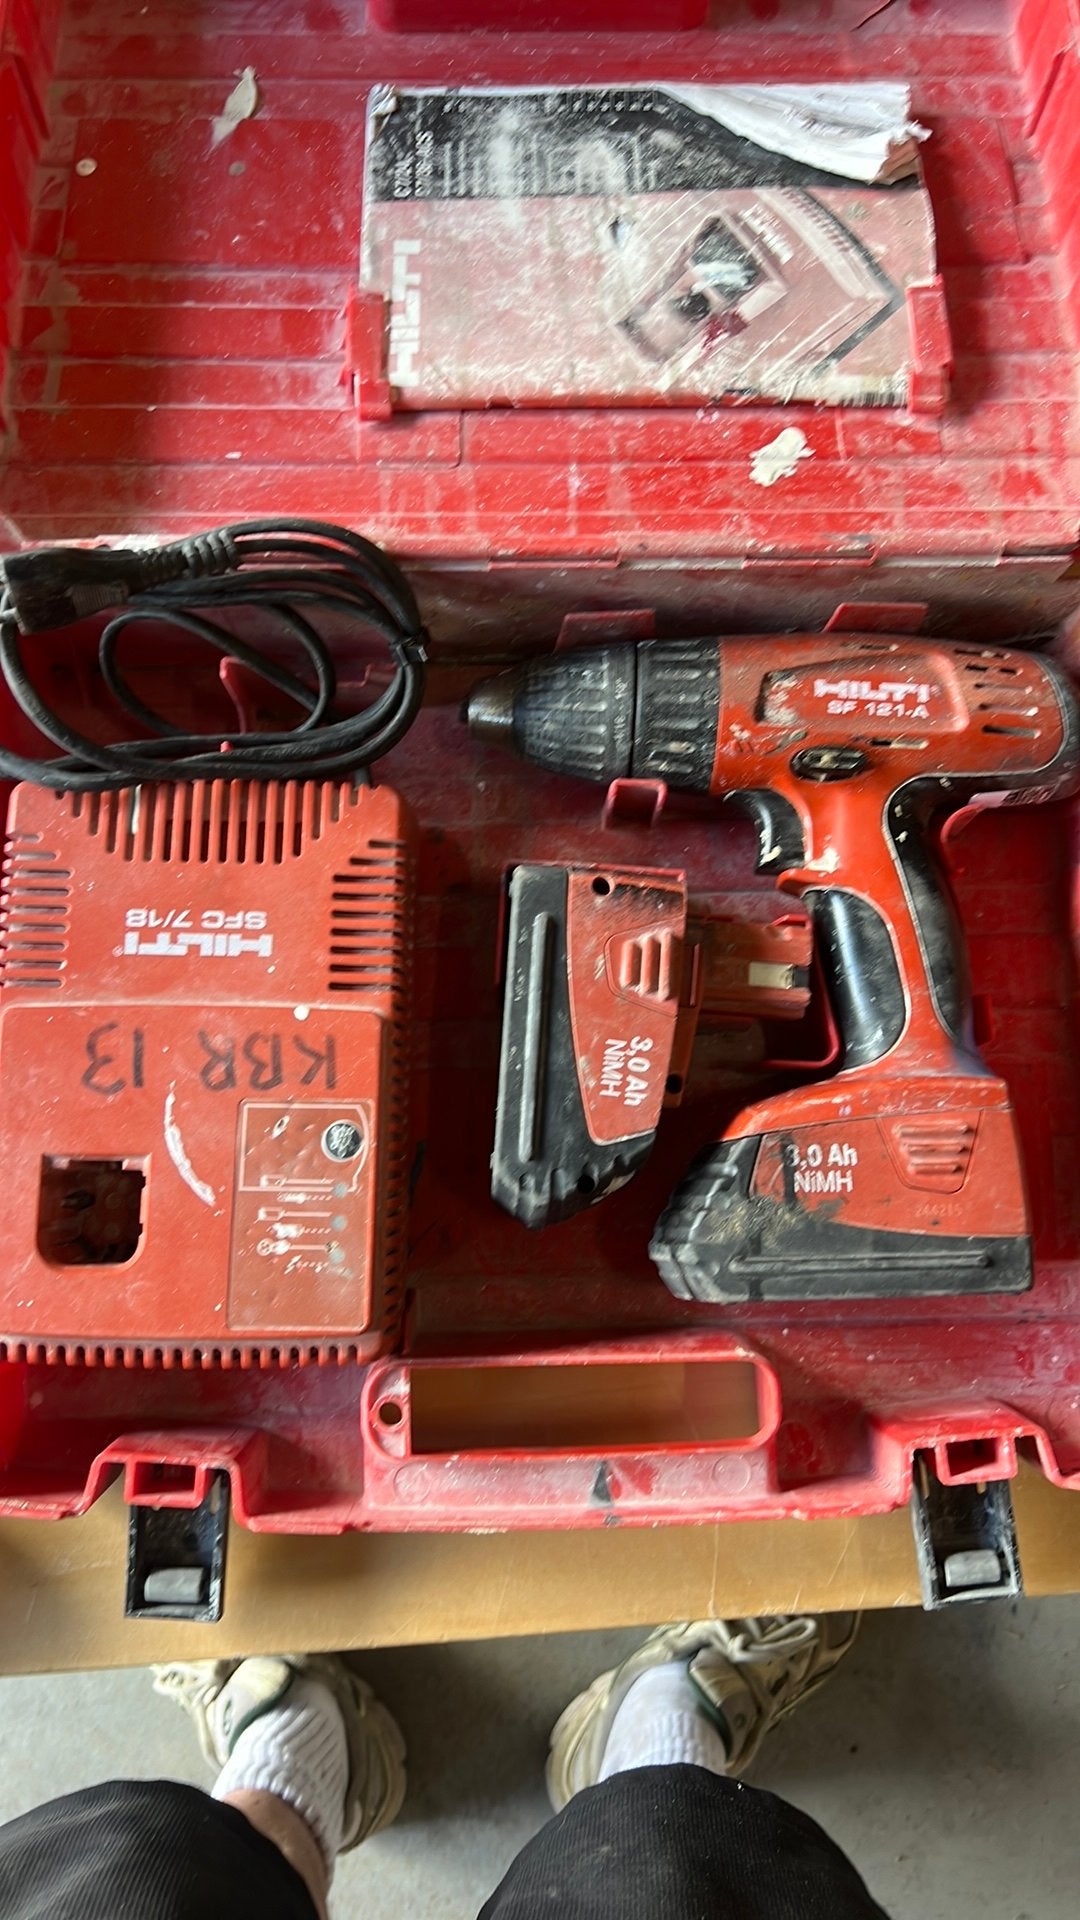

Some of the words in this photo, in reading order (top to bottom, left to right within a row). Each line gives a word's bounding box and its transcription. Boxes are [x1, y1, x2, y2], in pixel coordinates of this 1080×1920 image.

[390, 239, 421, 388] HILTI
[814, 679, 930, 702] HILTI
[827, 700, 857, 715] SF
[125, 908, 193, 929] 7/18
[201, 910, 268, 929] SFC
[124, 930, 273, 958] HILTI
[82, 1022, 146, 1096] 13
[198, 1029, 338, 1091] KBR
[598, 1038, 626, 1098] NiMH
[625, 1036, 654, 1073] 3,0
[624, 1074, 649, 1107] Ah
[827, 1142, 858, 1167] Ah
[793, 1169, 854, 1193] NiMH
